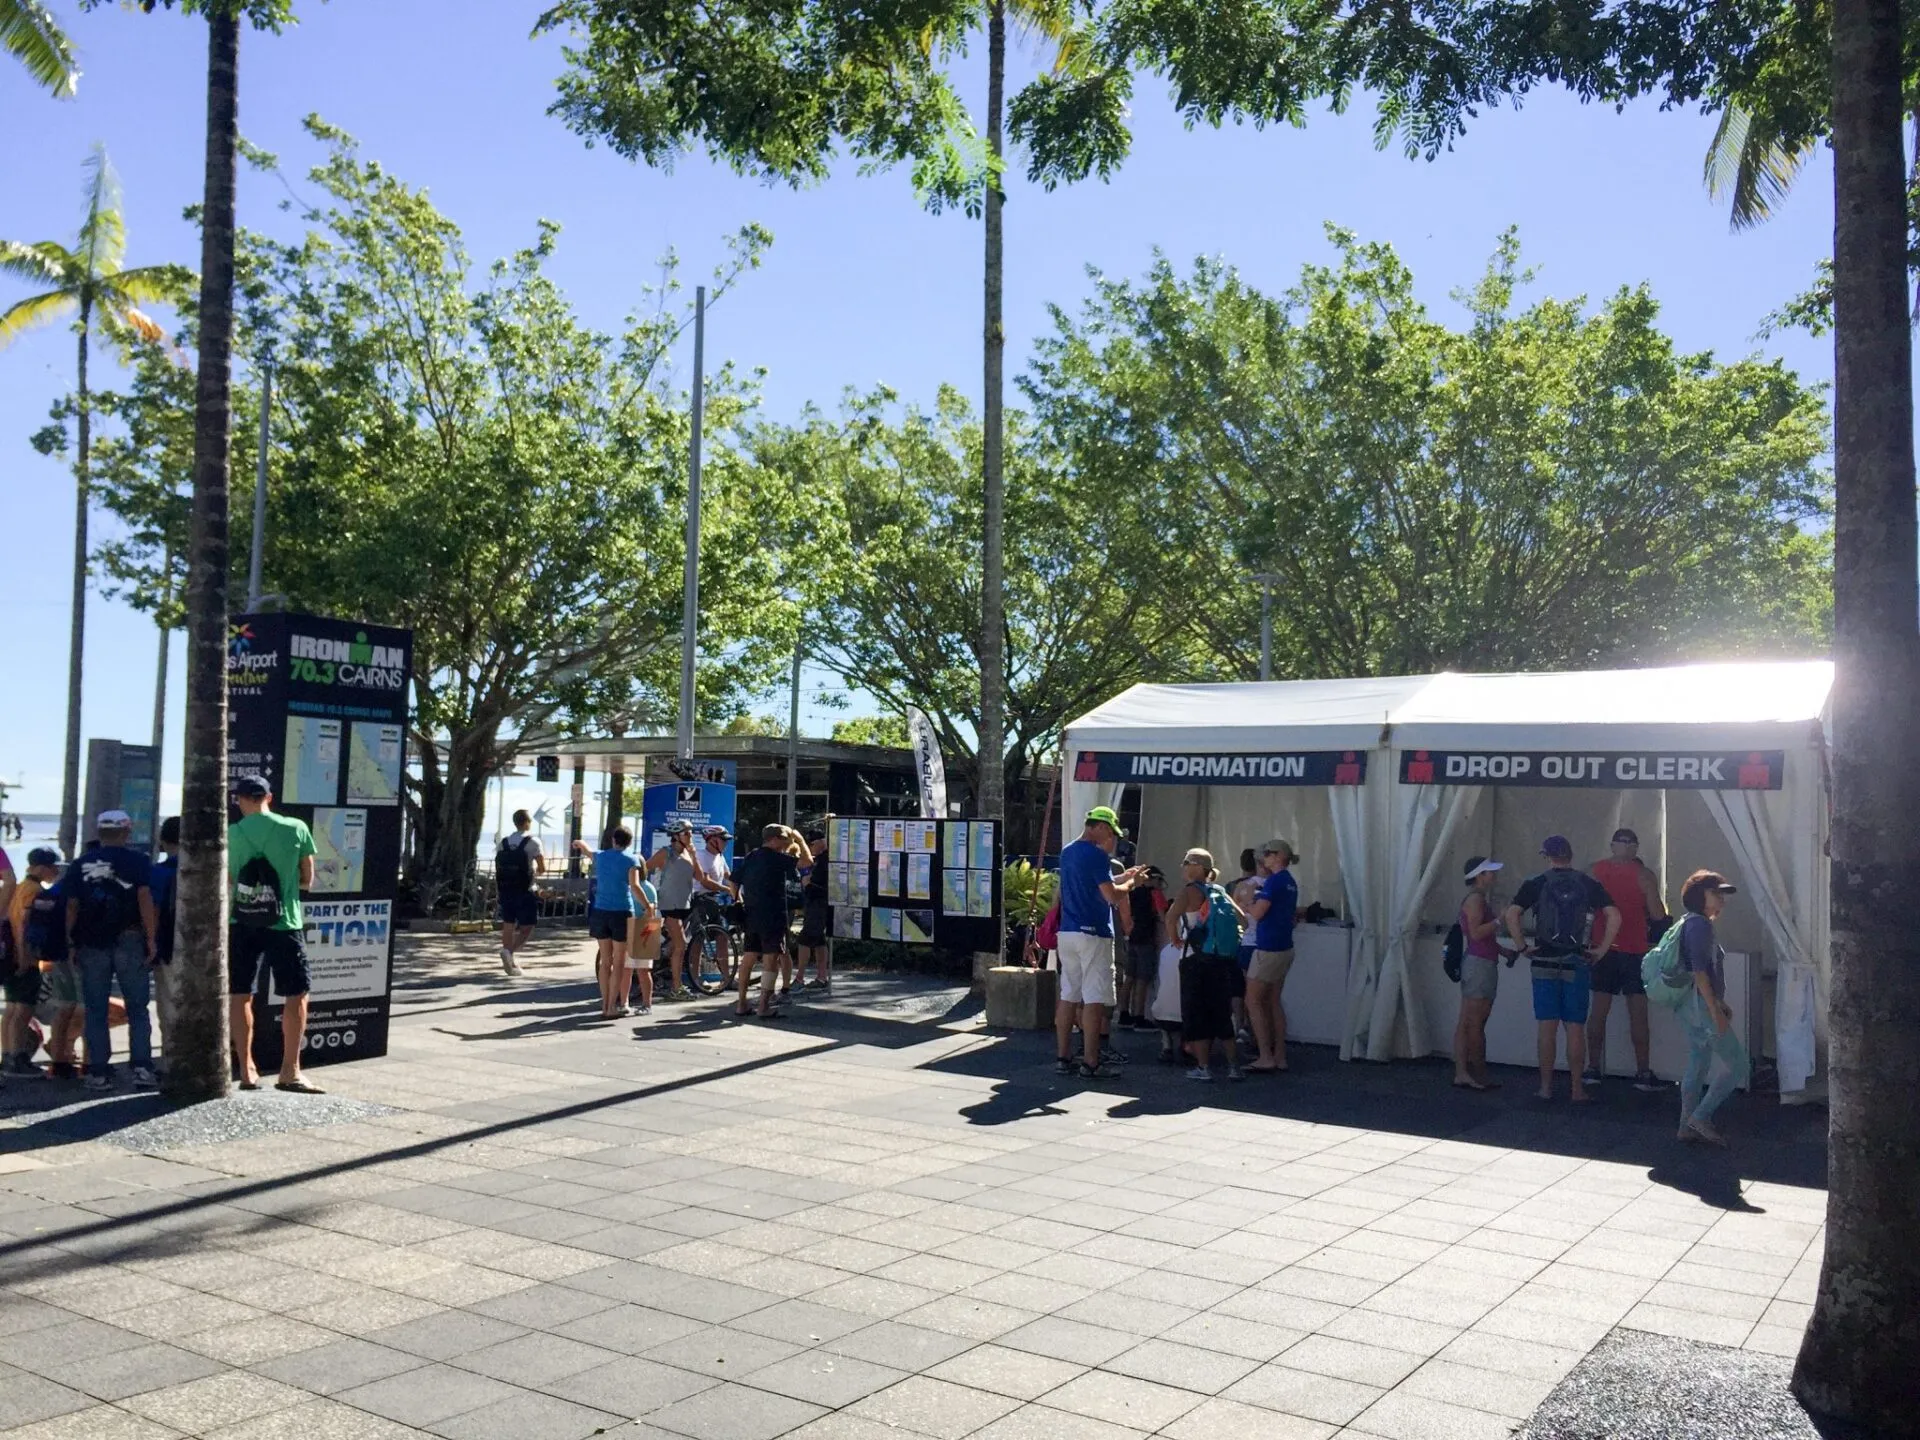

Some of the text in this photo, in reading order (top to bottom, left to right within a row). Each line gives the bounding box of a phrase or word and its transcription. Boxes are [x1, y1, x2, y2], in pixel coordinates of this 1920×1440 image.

[238, 650, 277, 672] Airport
[290, 631, 404, 669] IRONMAN
[290, 659, 335, 684] 70.3
[338, 664, 403, 688] CAIRNS
[231, 687, 263, 696] TIVAL
[1131, 756, 1305, 777] INFORMATION
[1445, 755, 1726, 782] DROP OUT CLERK
[304, 903, 389, 917] PART OF THE
[303, 920, 387, 947] CTION
